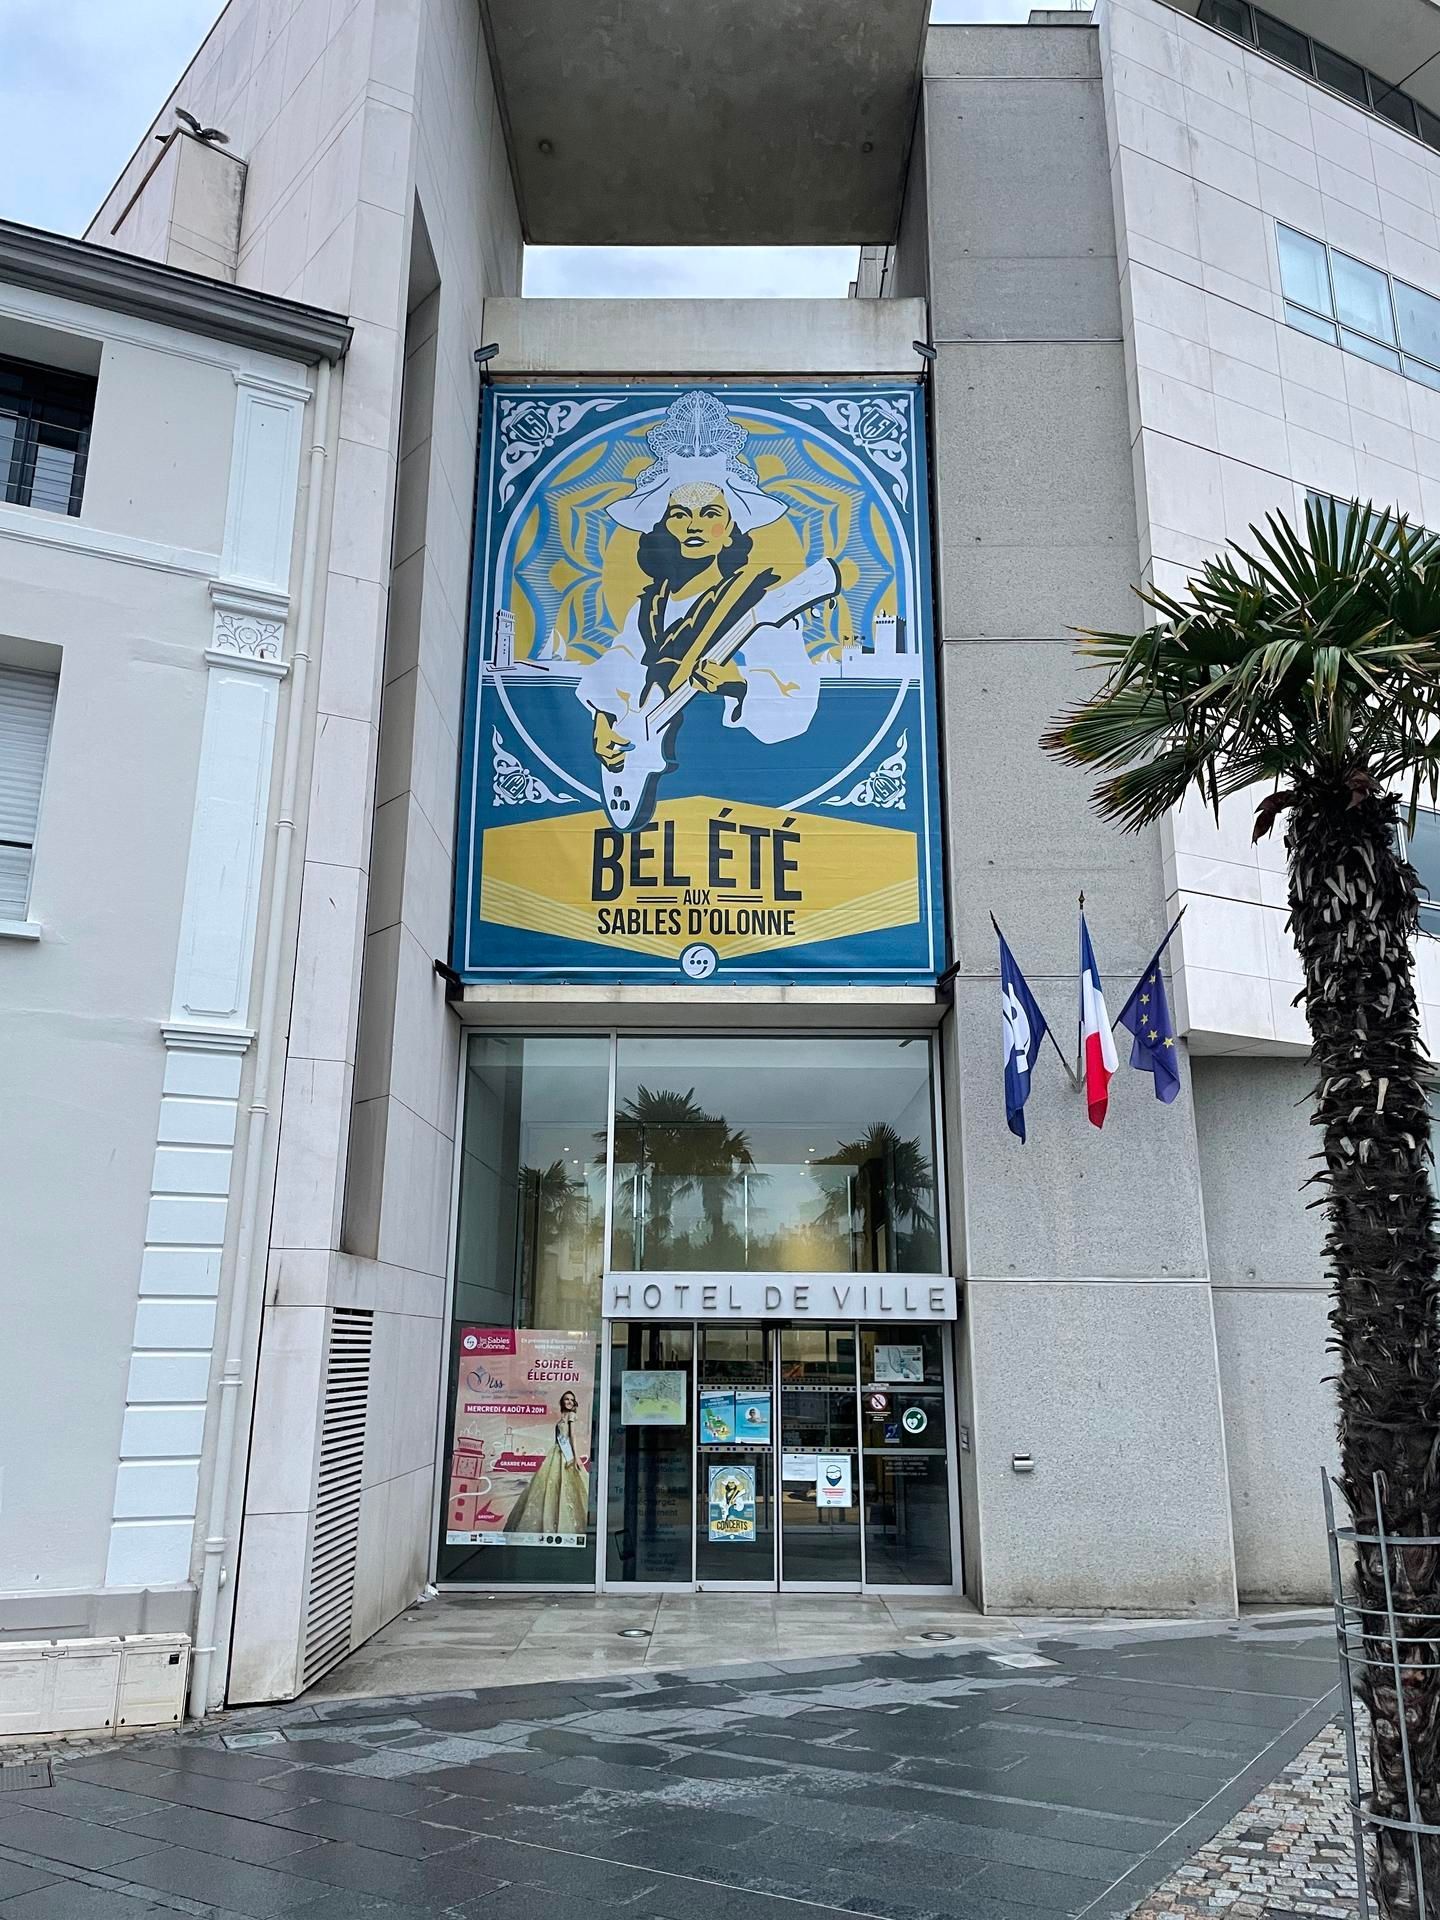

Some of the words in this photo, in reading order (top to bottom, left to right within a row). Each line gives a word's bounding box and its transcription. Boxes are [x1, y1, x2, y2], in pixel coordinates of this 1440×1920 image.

[591, 820, 691, 902] BEL
[708, 807, 803, 901] ÉTÉ
[683, 889, 711, 905] AUX
[597, 908, 682, 935] SABLES
[688, 909, 796, 936] D'OLONNE
[612, 1284, 742, 1310] HOTEL
[765, 1286, 810, 1310] DE
[832, 1286, 946, 1312] VILLE
[487, 1336, 510, 1344] Sables
[534, 1357, 574, 1369] SOIRÉE
[527, 1369, 580, 1382] ÉLECTION
[507, 1405, 525, 1413] AOÛT
[526, 1405, 531, 1413] À
[716, 1519, 748, 1531] CONCERTS
